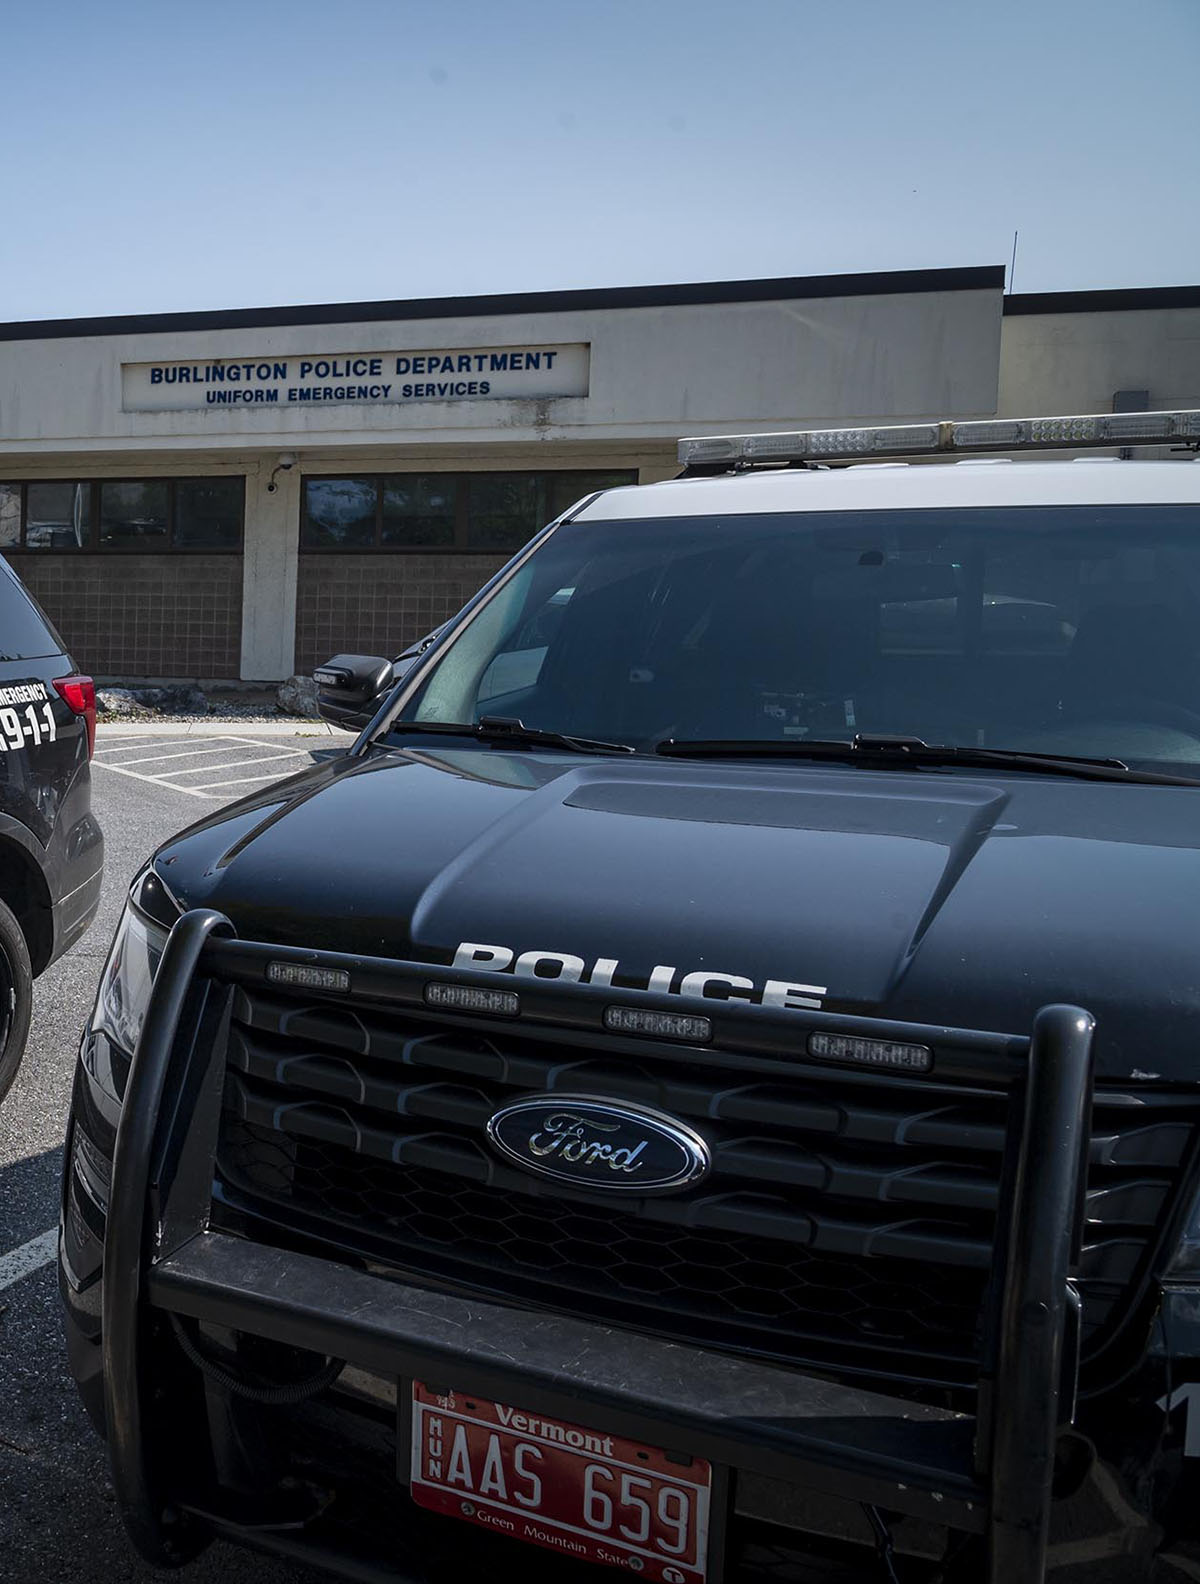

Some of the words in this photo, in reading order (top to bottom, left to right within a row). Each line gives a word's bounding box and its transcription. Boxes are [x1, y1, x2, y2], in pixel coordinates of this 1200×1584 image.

[151, 363, 287, 384] BURLINGTON
[300, 359, 382, 379] POLICE
[396, 352, 557, 375] DEPARTMENT
[206, 388, 278, 403] UNIFORM
[288, 384, 392, 401] EMERGENCY
[402, 381, 490, 397] SERVICES
[529, 1113, 650, 1174] Ford
[428, 1416, 442, 1479] MUN
[494, 1403, 614, 1457] Vermont
[447, 1424, 542, 1508] AAS
[583, 1463, 688, 1554] 659
[477, 1509, 514, 1531] Green
[524, 1524, 587, 1555] Mountain
[596, 1548, 629, 1567] State
